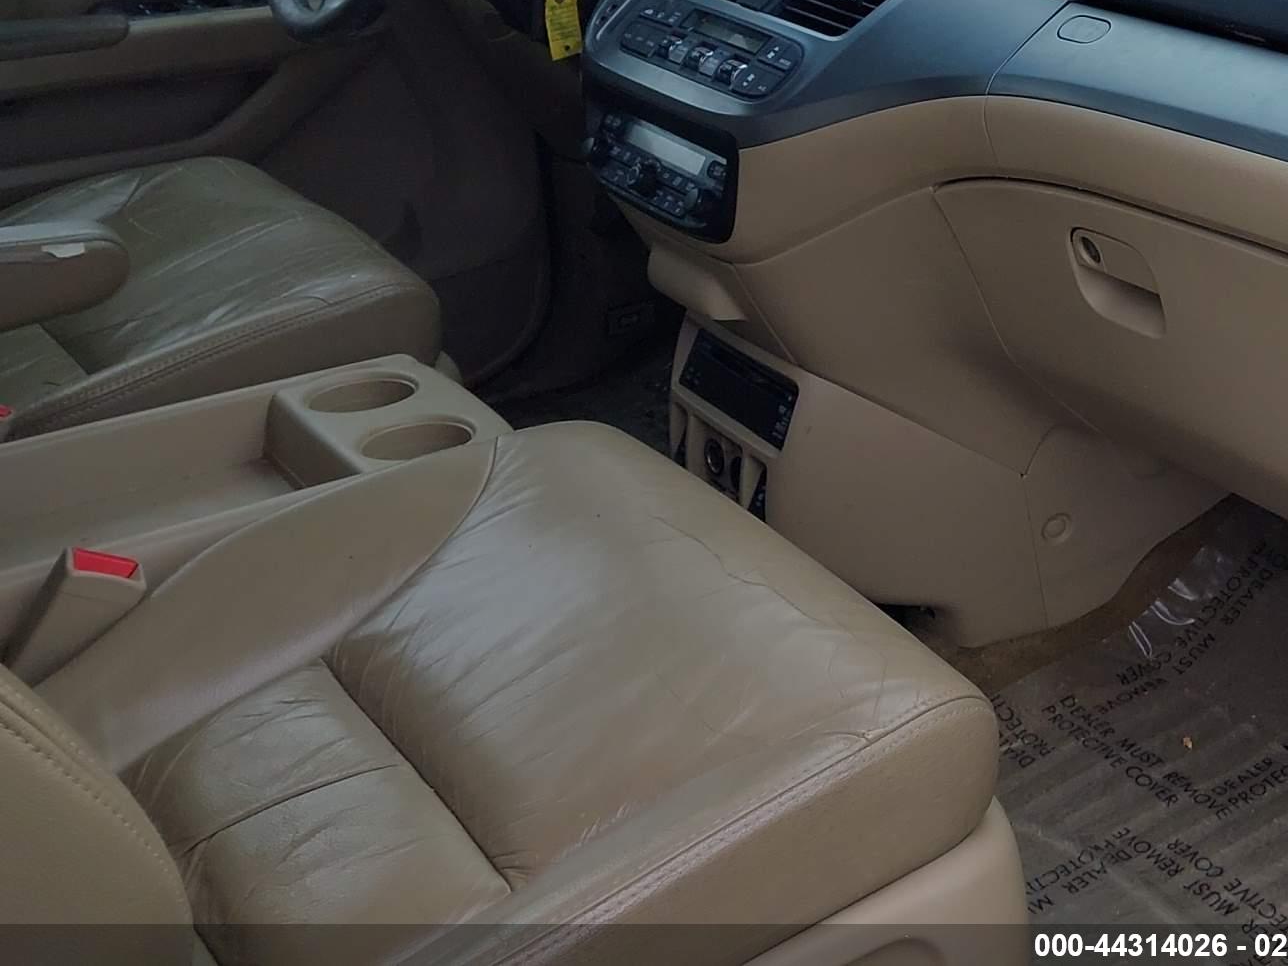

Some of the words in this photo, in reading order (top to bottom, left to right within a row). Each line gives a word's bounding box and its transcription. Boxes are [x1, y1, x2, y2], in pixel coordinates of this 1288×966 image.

[1220, 567, 1274, 627] DEALER
[1171, 631, 1218, 677] MUST
[1041, 703, 1128, 770] PROTECTIVE
[1124, 764, 1181, 809] COVER
[1058, 693, 1117, 739] DEALER
[1117, 736, 1167, 770] MUST
[1161, 770, 1233, 821] REMOVE
[1210, 754, 1274, 797] DEALER
[1060, 849, 1134, 895] DEALER
[1111, 826, 1186, 879] REMOVE
[1165, 837, 1226, 879] COVER
[1182, 879, 1240, 917] MUST
